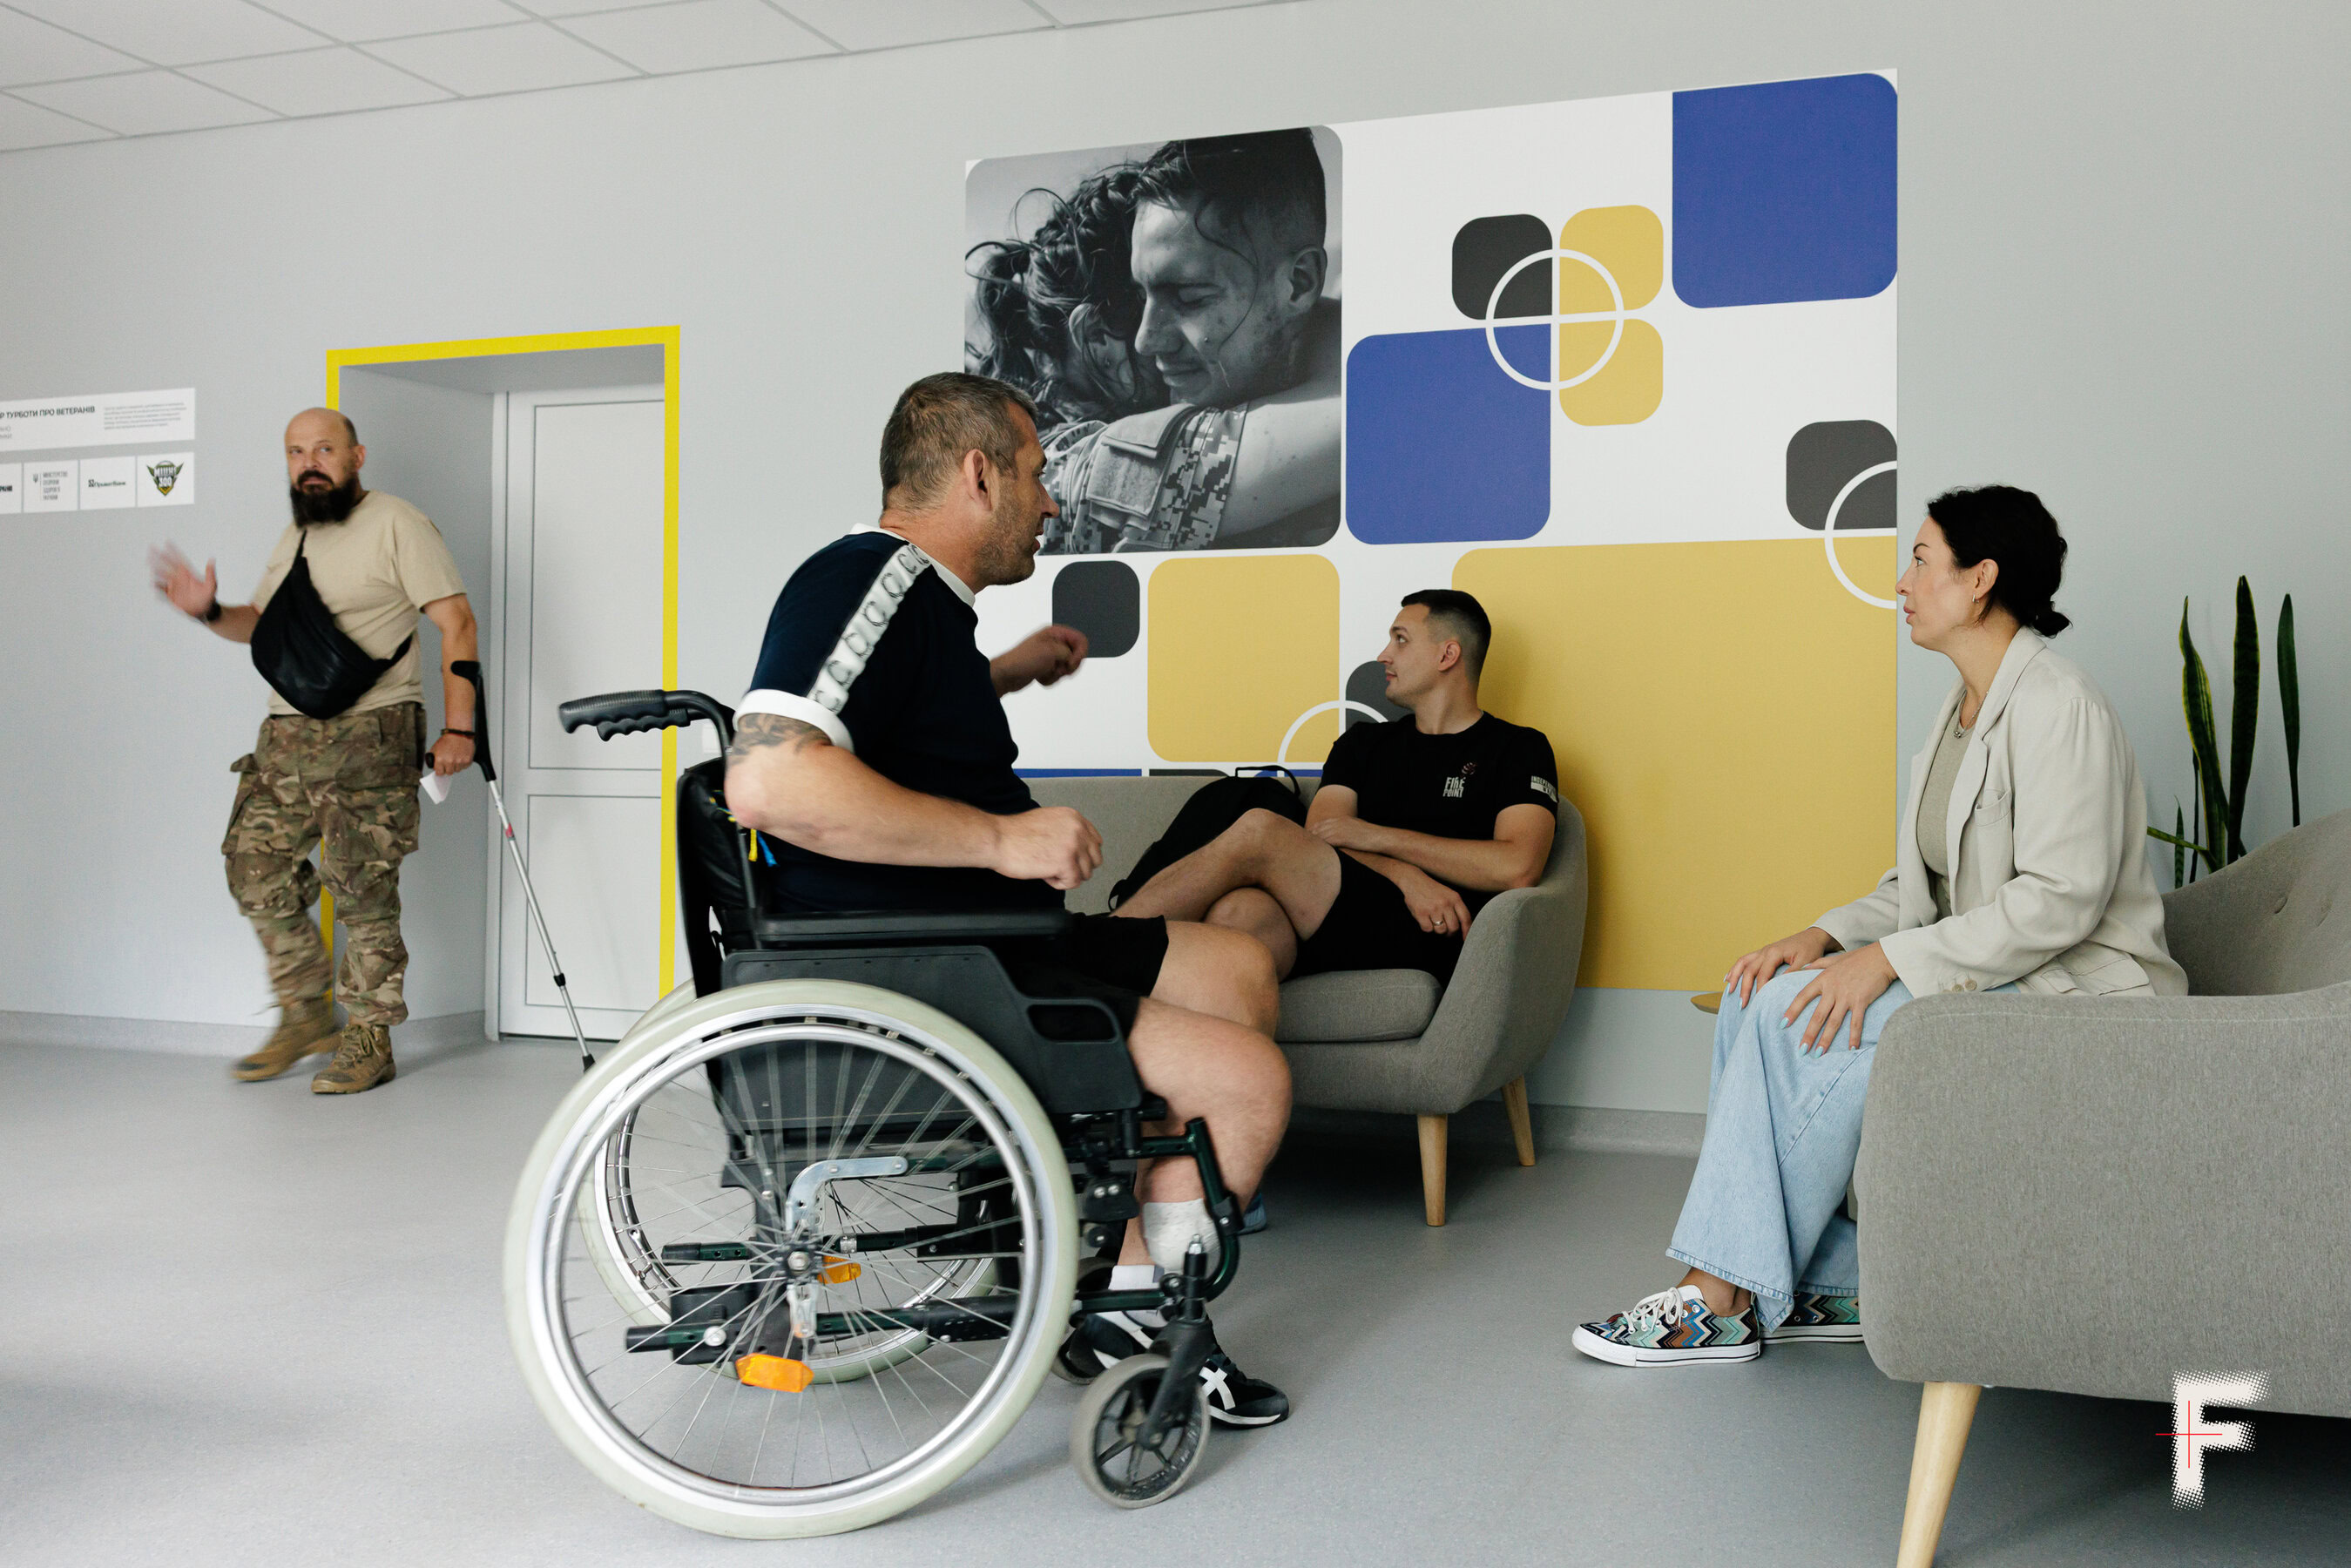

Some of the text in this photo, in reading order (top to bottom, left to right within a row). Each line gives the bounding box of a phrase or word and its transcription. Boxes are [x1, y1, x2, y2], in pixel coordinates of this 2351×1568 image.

[6, 409, 37, 419] ТУРБОТИ
[57, 406, 95, 416] ВЕТЕРАНІВ
[1445, 777, 1466, 789] FIRE
[1442, 787, 1464, 798] POINT
